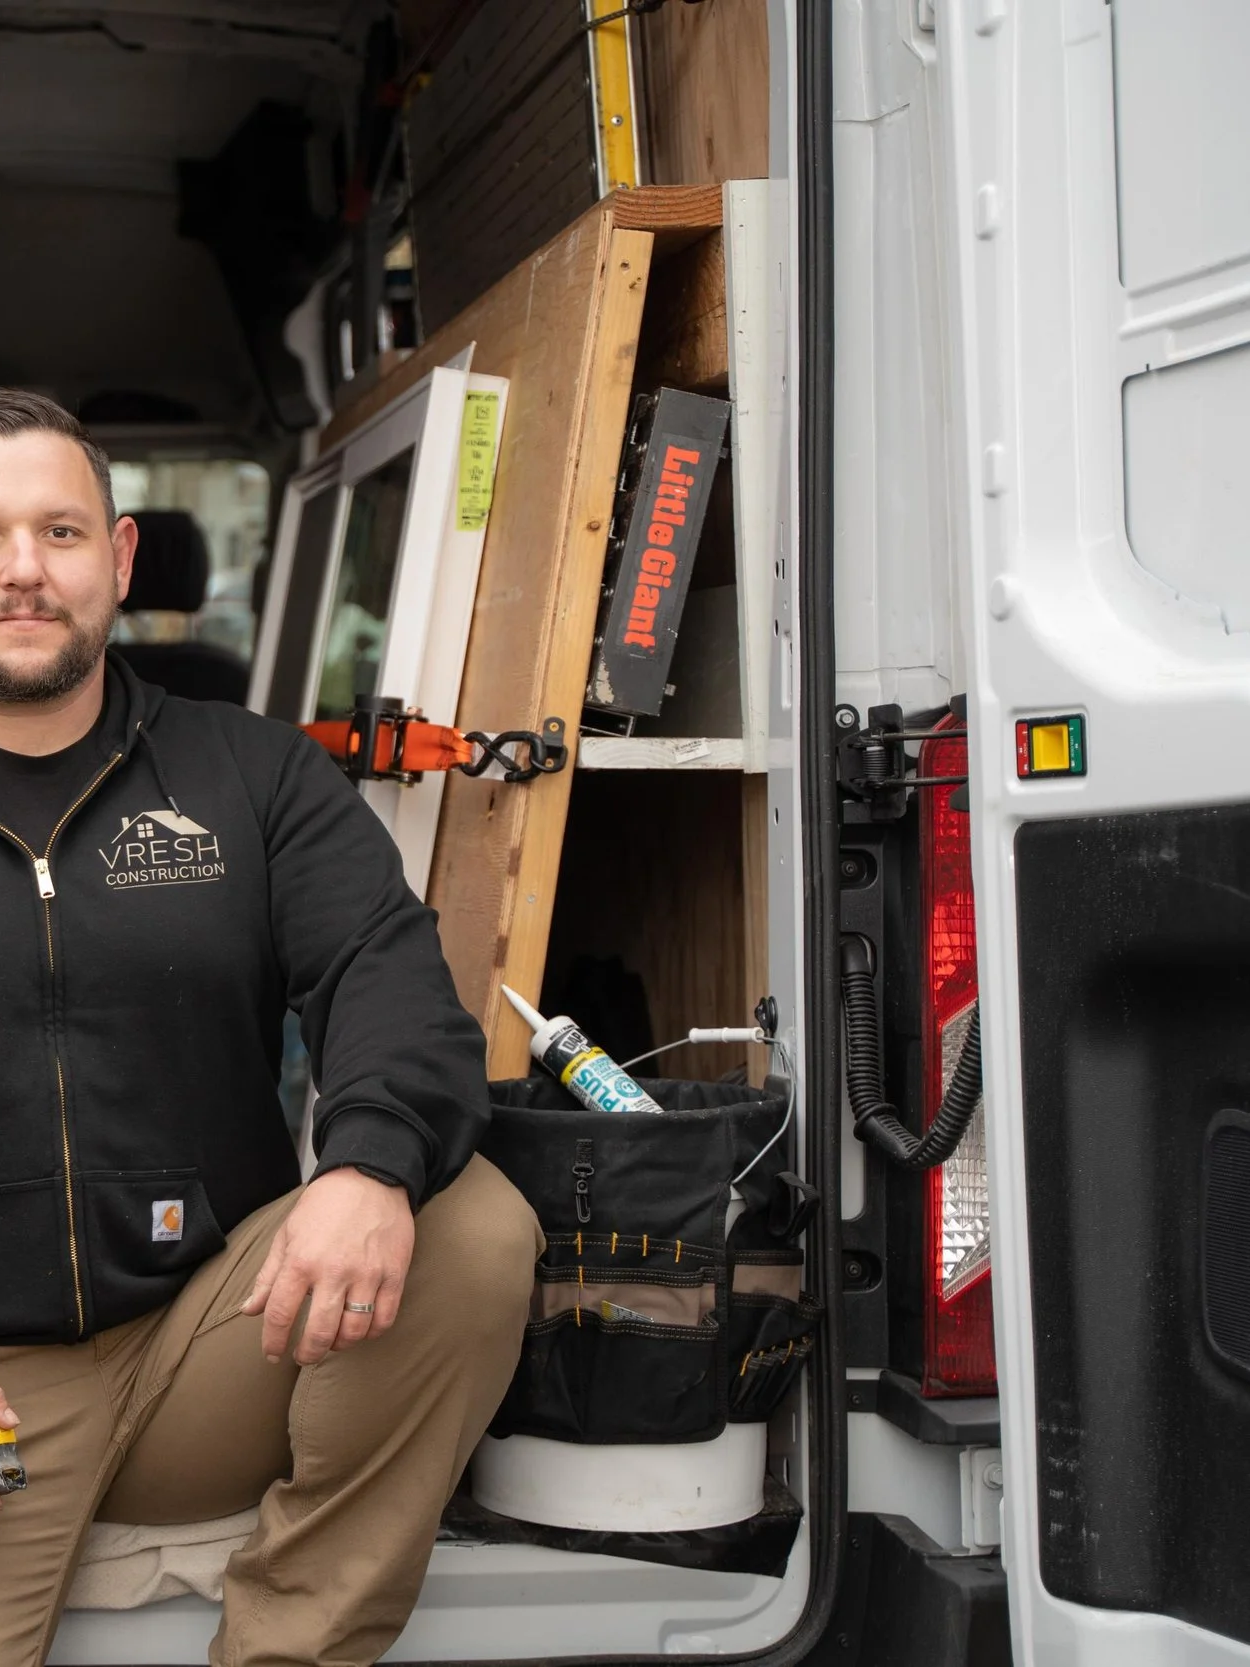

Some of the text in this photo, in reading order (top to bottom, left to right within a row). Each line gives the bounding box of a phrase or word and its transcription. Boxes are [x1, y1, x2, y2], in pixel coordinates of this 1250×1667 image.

[623, 445, 700, 649] Little Giant
[99, 835, 220, 870] VRESH
[106, 861, 225, 886] CONSTRUCTION
[561, 1031, 584, 1052] DAP
[576, 1068, 620, 1112] PLUS
